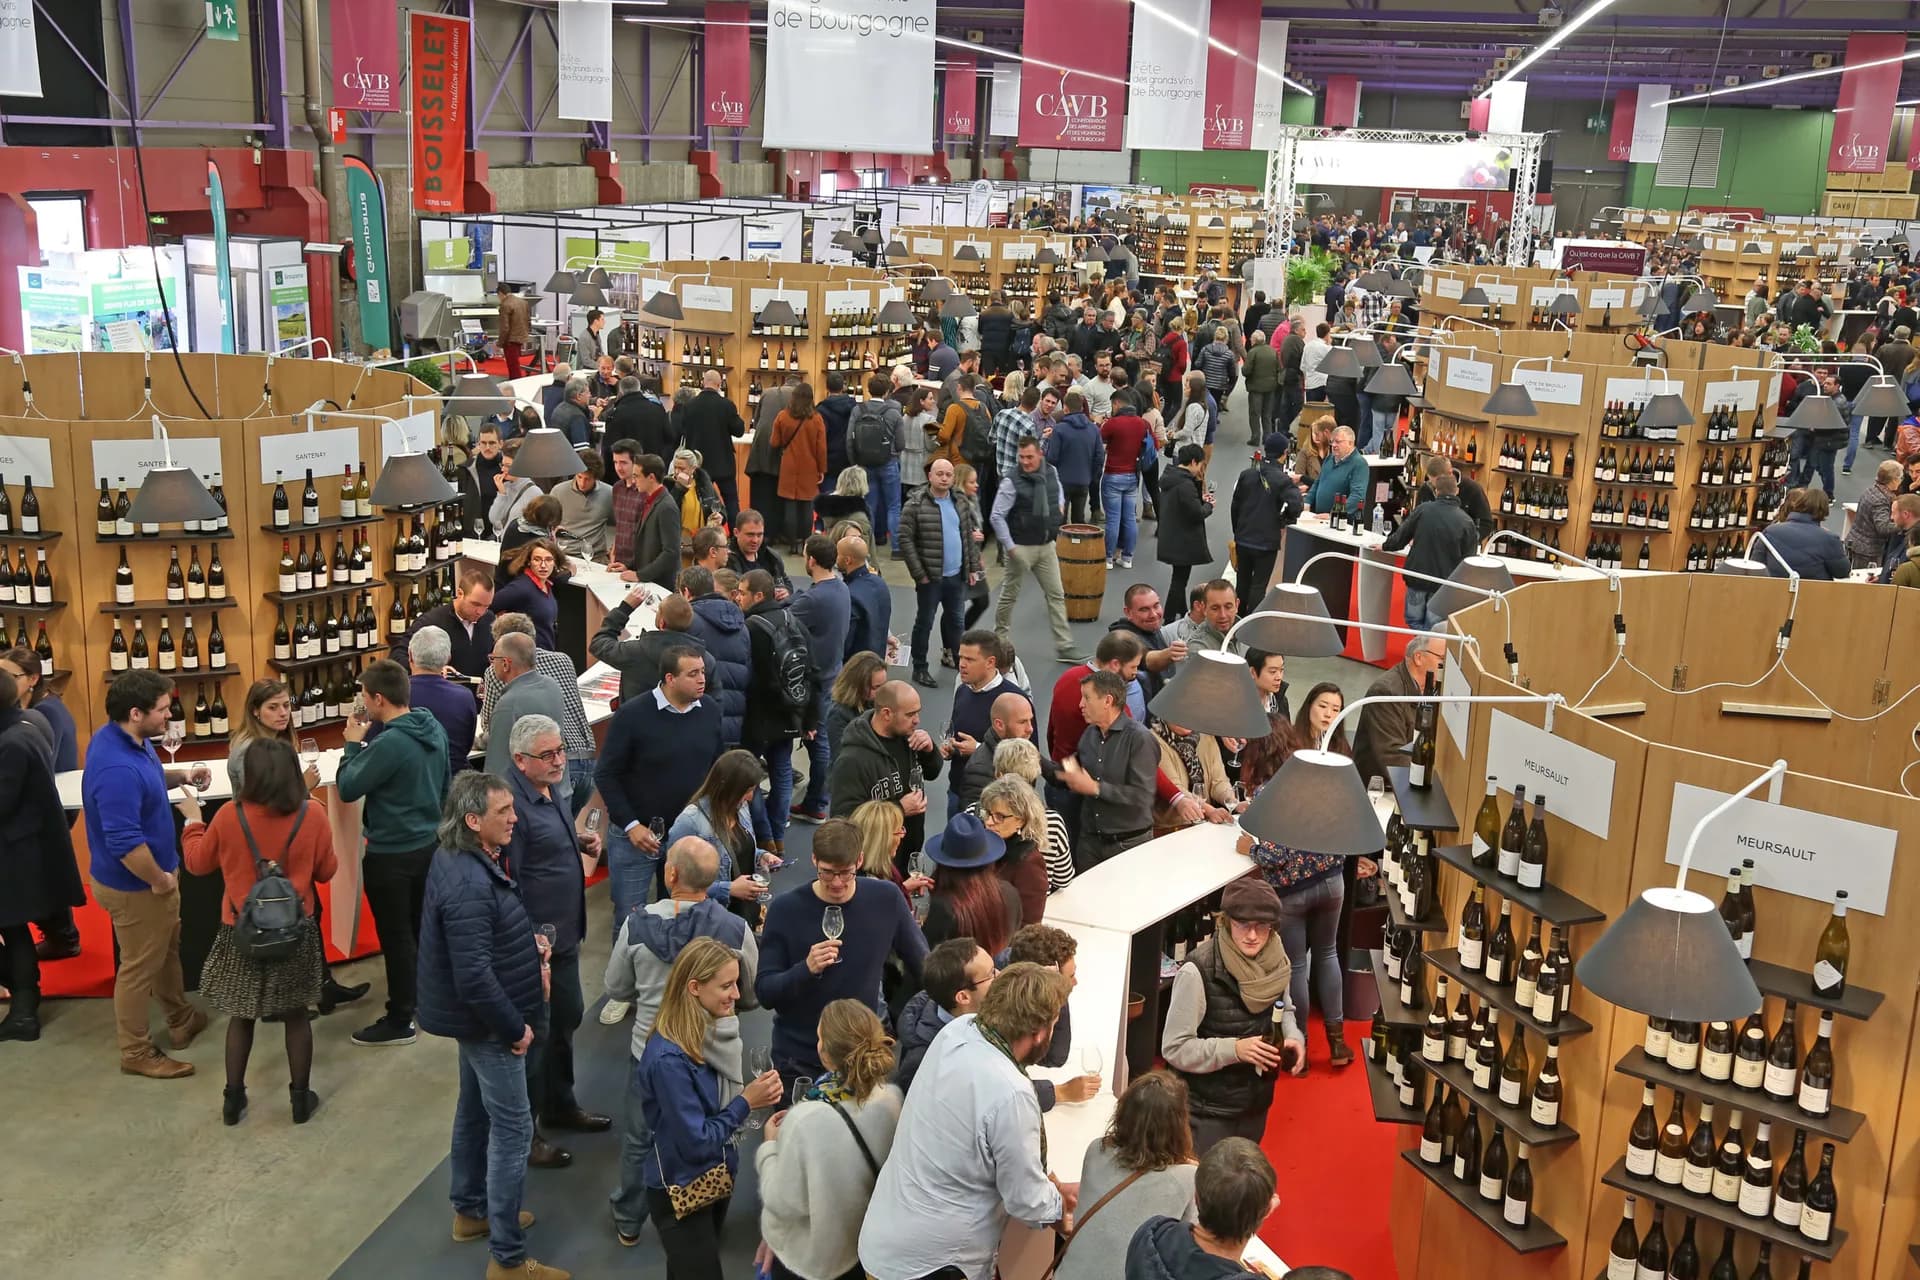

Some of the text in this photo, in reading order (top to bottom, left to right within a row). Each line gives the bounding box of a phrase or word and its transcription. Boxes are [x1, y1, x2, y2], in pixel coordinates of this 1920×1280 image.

[773, 5, 929, 38] de Bourgogne
[343, 72, 390, 90] CAVB
[1148, 86, 1203, 100] Bourgogne
[421, 19, 446, 193] BOISSELET
[711, 101, 744, 113] CAVB
[1035, 93, 1108, 118] CAVB
[1838, 145, 1879, 157] CAVB
[295, 451, 326, 461] SANTENAY
[1524, 758, 1569, 787] MEURSAULT
[1736, 834, 1816, 862] MEURSAULT
